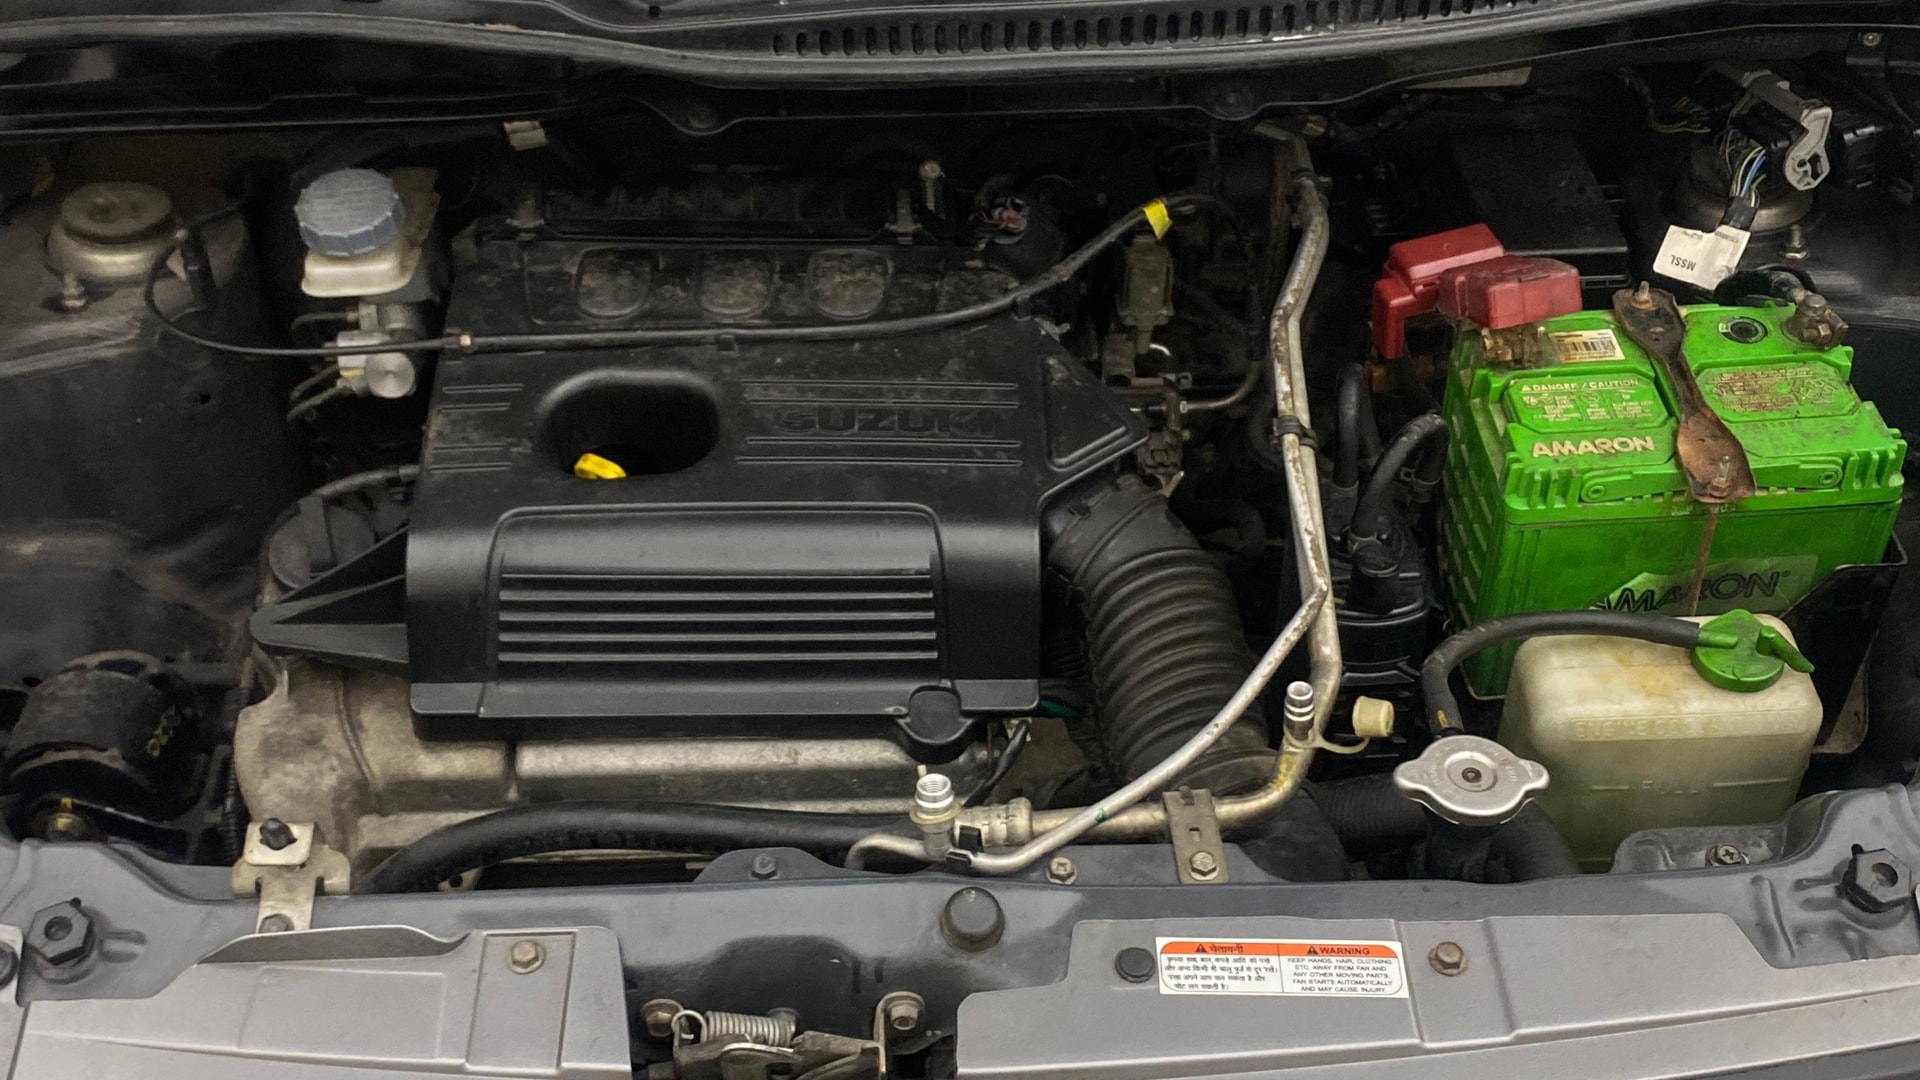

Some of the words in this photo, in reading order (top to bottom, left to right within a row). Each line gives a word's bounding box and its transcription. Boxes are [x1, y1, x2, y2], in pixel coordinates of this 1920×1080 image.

[1671, 254, 1697, 271] MSSL
[1532, 382, 1577, 391] DANGER
[1590, 379, 1639, 389] CAUTION
[776, 407, 995, 437] SUZUKI
[1532, 435, 1655, 458] AMARON
[1320, 947, 1370, 955] WARNING
